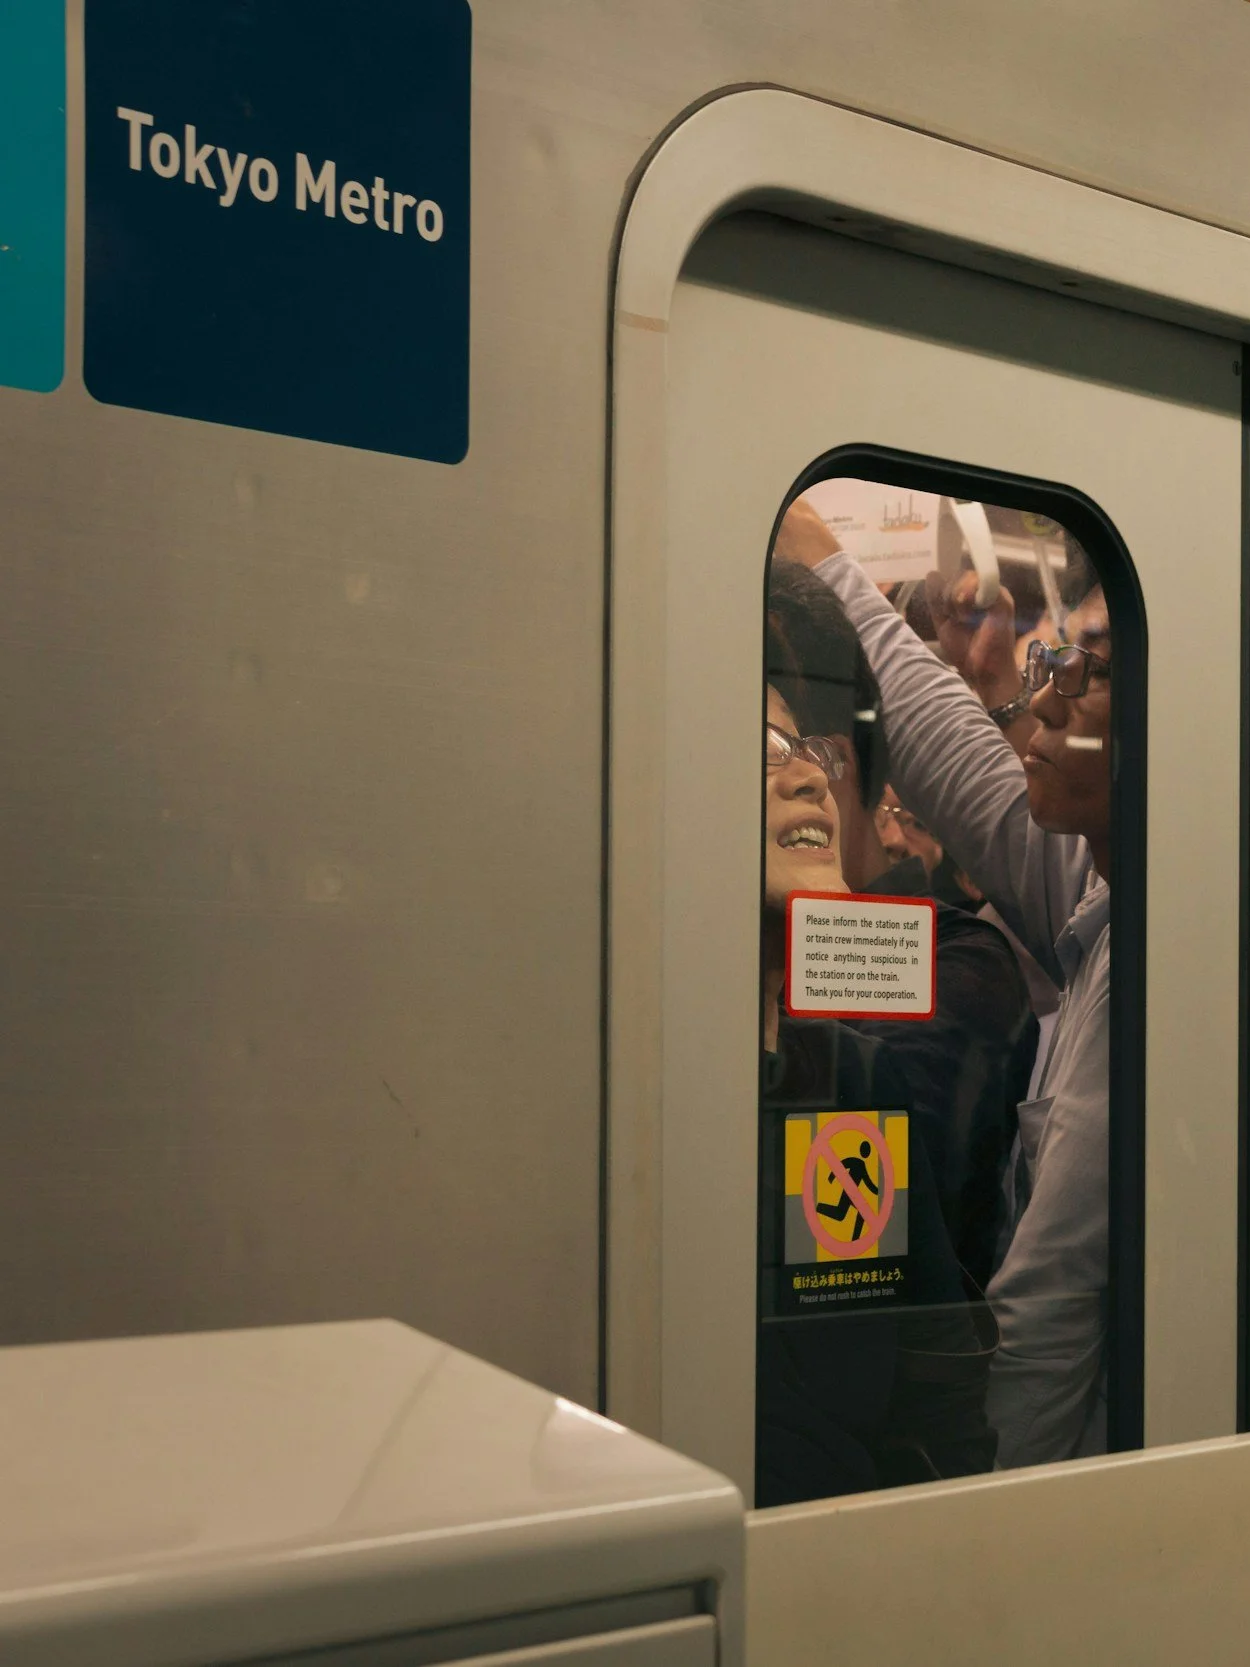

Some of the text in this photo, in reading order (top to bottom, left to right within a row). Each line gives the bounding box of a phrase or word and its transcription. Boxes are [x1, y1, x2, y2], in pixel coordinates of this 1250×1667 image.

[117, 106, 444, 242] Tokyo Metro
[807, 915, 919, 930] Please inform the station staff
[816, 934, 833, 943] train
[835, 936, 851, 944] crew
[854, 935, 897, 948] immediately
[899, 937, 905, 947] if
[906, 939, 918, 949] you
[806, 951, 918, 965] notice anything suspicious in
[806, 969, 818, 978] the
[820, 970, 845, 979] station
[857, 972, 865, 980] on
[868, 971, 879, 981] the
[881, 972, 899, 981] train.
[806, 986, 917, 1001] Thank you for your cooperation.
[800, 1294, 818, 1303] Please
[828, 1293, 836, 1301] not
[837, 1292, 849, 1300] rush
[850, 1291, 856, 1299] to
[857, 1290, 871, 1298] catch
[872, 1289, 881, 1297] the
